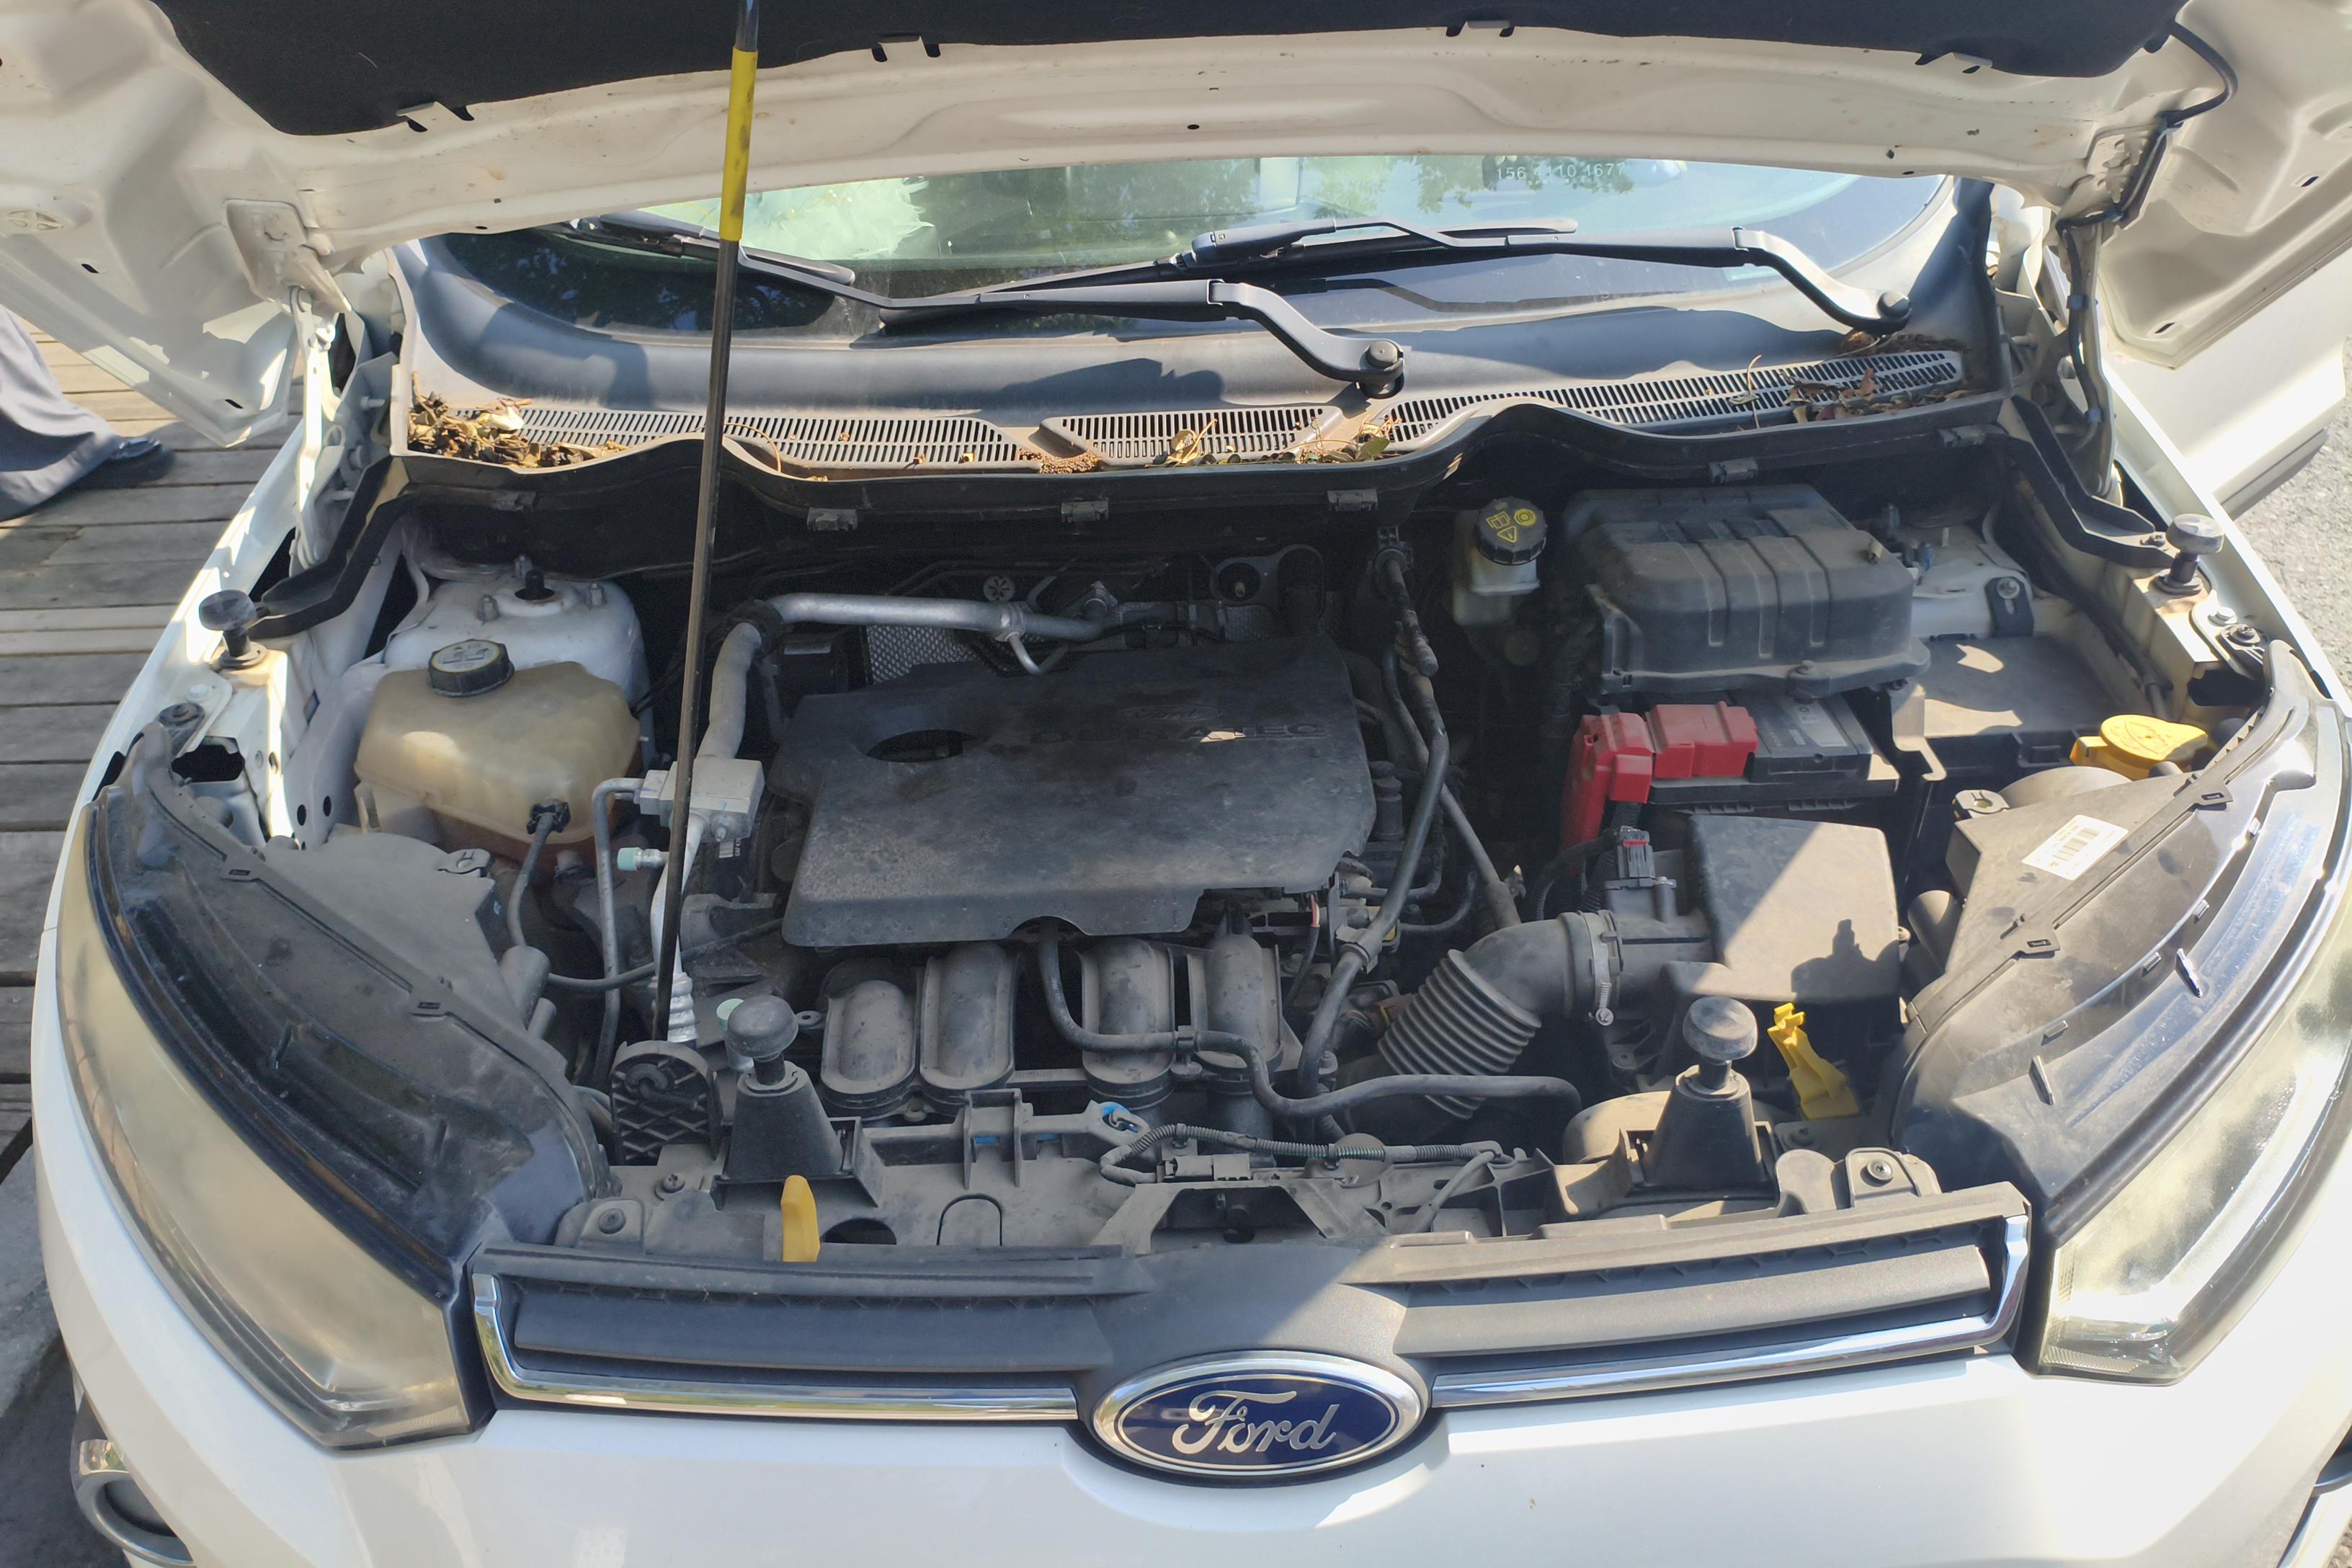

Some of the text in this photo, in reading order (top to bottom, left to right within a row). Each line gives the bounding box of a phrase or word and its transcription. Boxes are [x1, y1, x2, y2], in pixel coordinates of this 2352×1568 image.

[1496, 166, 1526, 180] 156
[1585, 162, 1626, 177] 1677
[1030, 724, 1326, 745] DATEC
[1172, 1390, 1339, 1454] Ford
